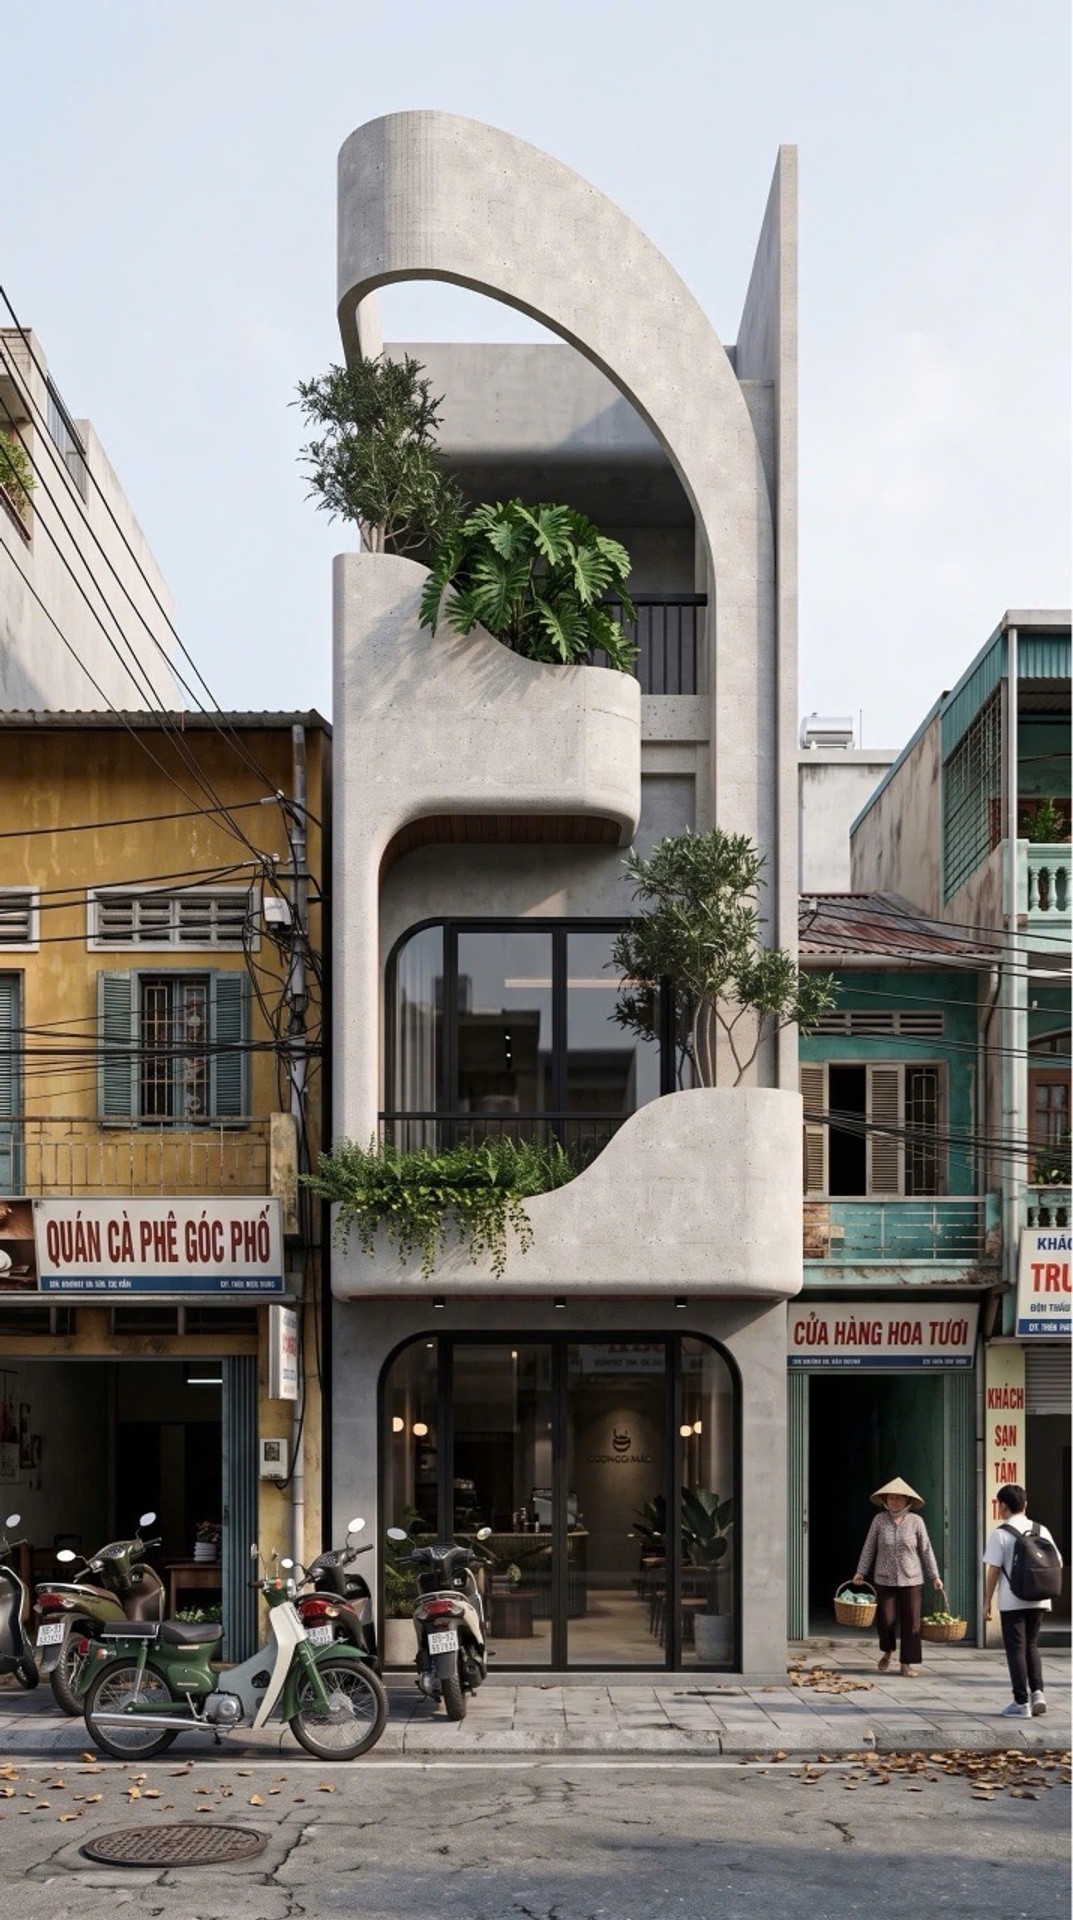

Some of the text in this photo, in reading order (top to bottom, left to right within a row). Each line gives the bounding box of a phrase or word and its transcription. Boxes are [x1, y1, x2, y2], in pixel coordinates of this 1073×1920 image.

[47, 1204, 271, 1269] QUÁN CÀ PHÊ GÓC PHỐ
[793, 1310, 971, 1346] CỬA HÀNG HOA TƯƠI
[994, 1424, 1017, 1451] SẠN
